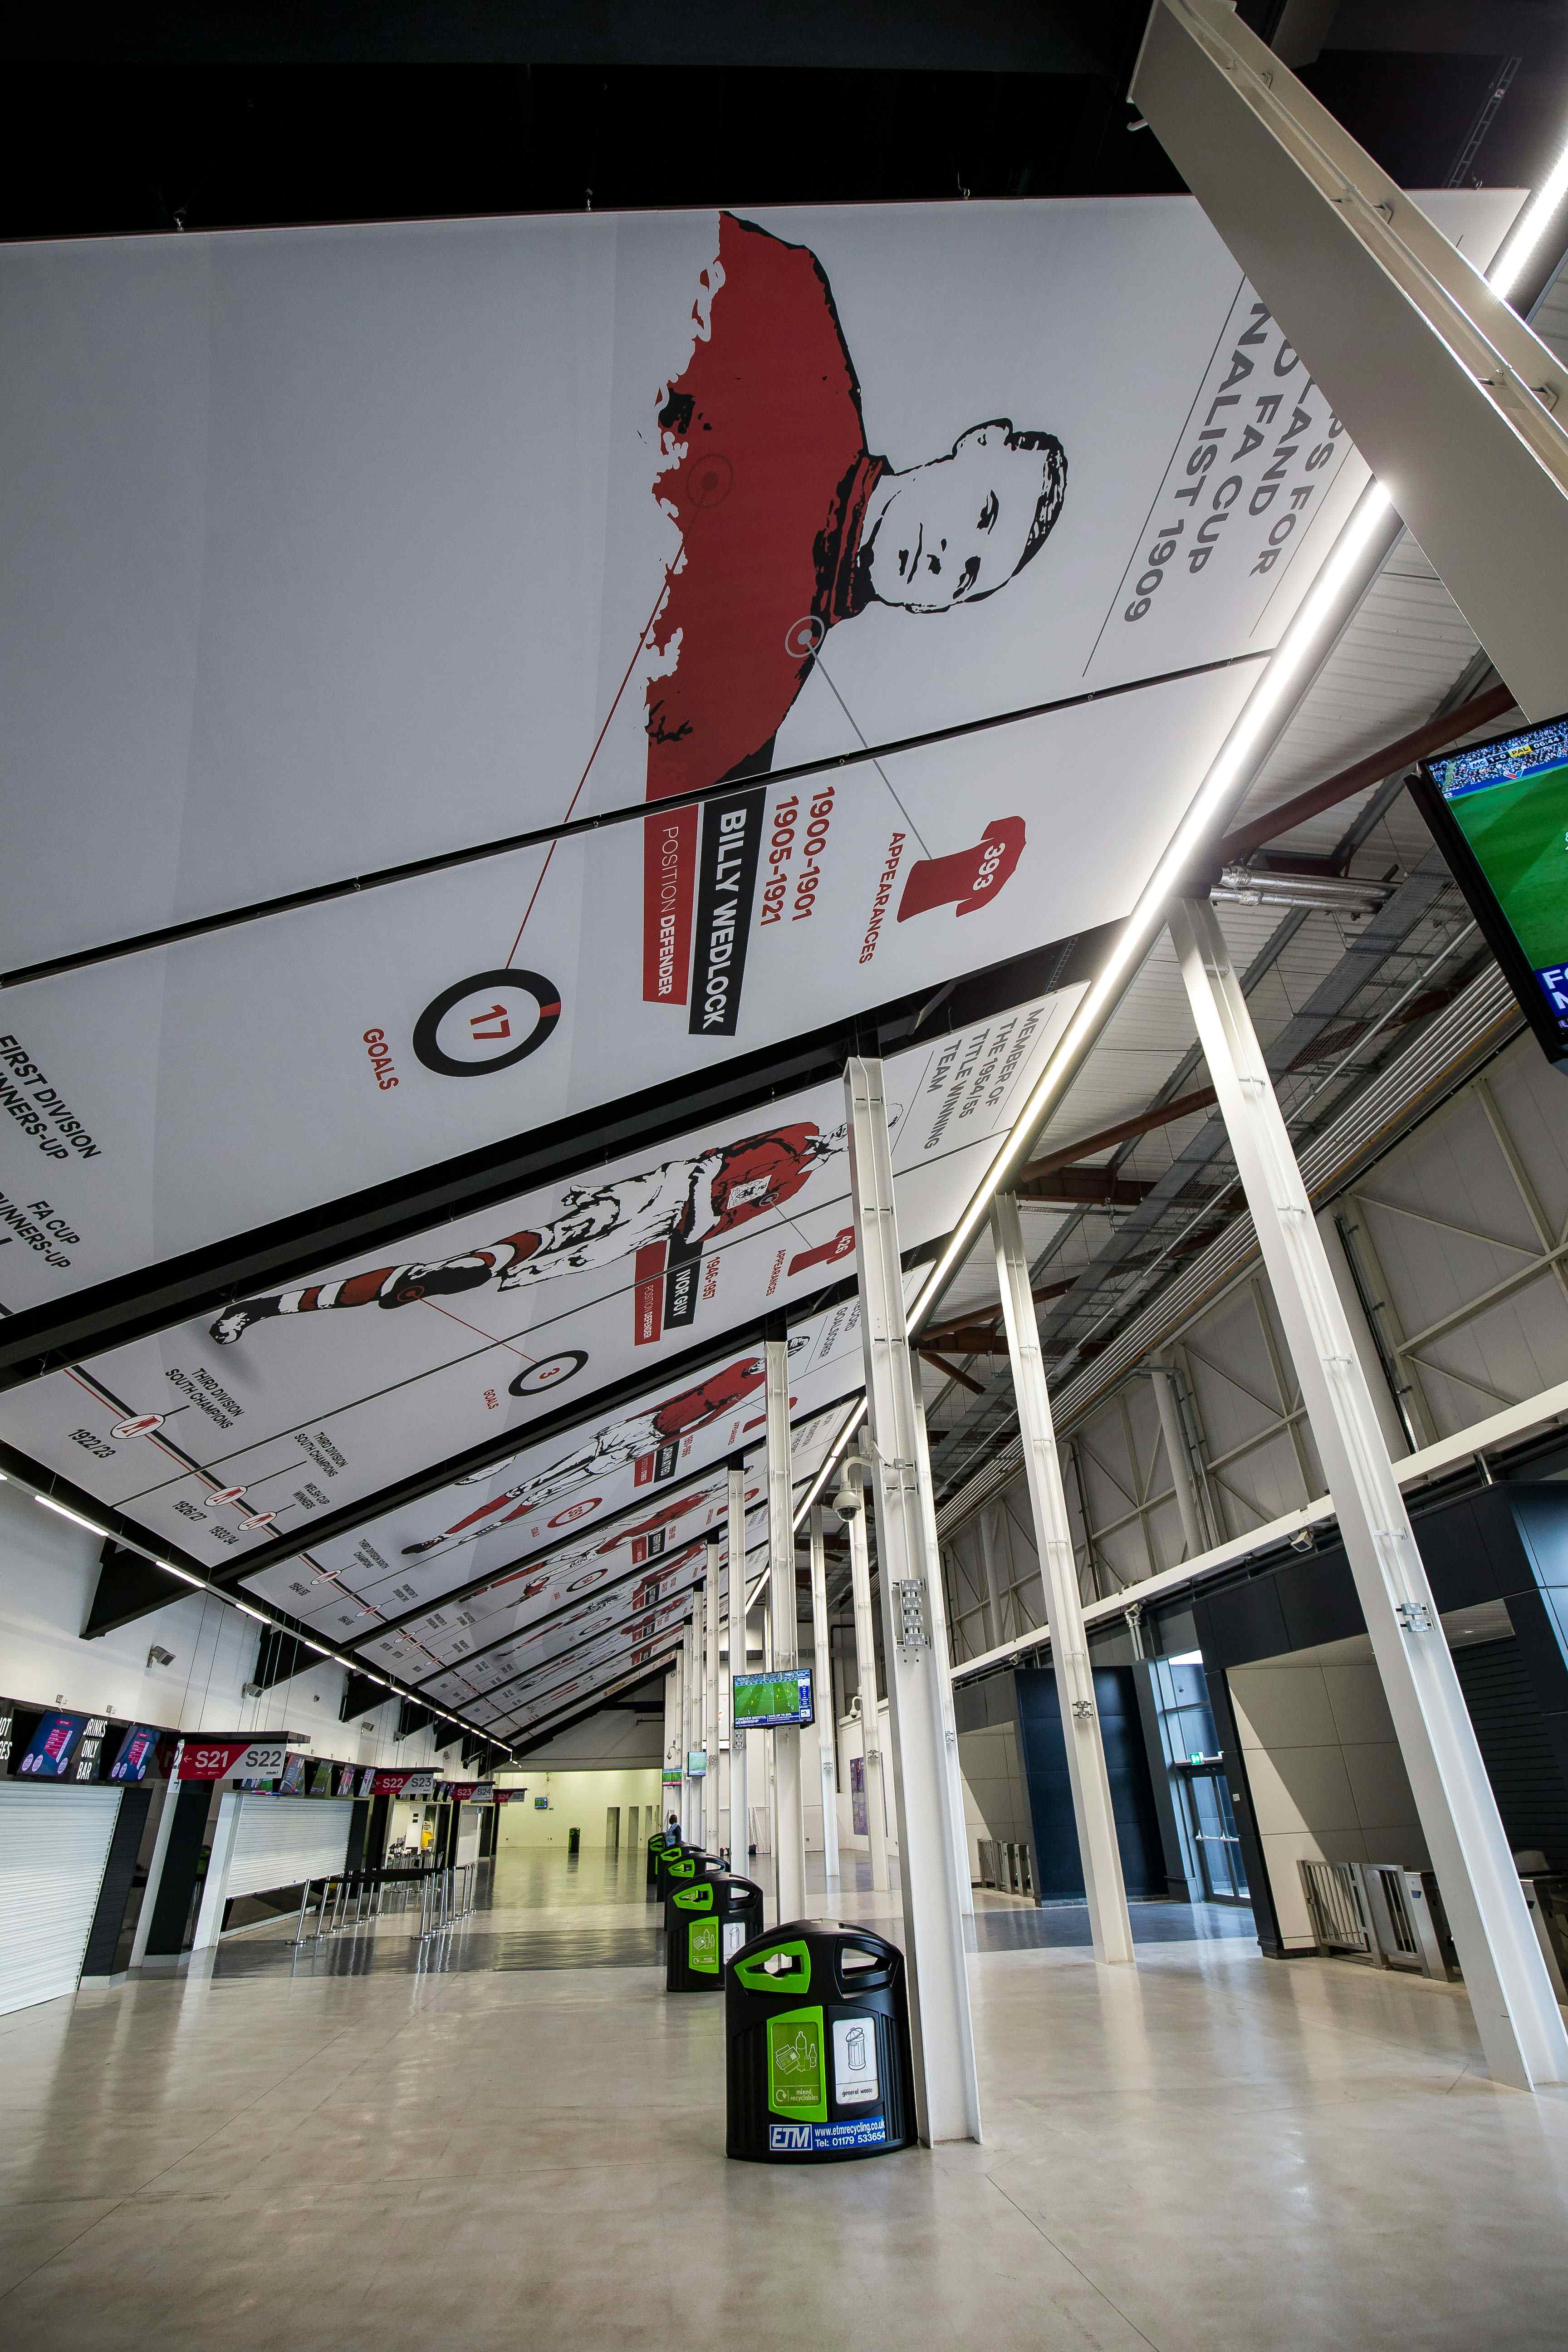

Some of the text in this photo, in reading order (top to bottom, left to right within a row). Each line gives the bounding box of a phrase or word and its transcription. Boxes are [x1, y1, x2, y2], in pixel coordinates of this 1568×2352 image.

[1124, 303, 1272, 622] NALIST 1909
[1187, 394, 1284, 574] FA CUP
[1249, 485, 1314, 577] FOR
[1489, 754, 1506, 762] 1-0
[1511, 747, 1529, 755] PAL
[1534, 737, 1560, 749] 06:44
[760, 794, 799, 926] 1905-1921
[792, 786, 835, 921] 1900-1901
[972, 842, 1006, 892] 393
[658, 826, 679, 997] POSITION DEFENDER
[702, 808, 747, 1030] BILLY WEDLOCK
[858, 831, 906, 965] APPEARANCES
[469, 1004, 511, 1040] 17
[363, 1027, 399, 1091] GOALS
[926, 1039, 962, 1093] TEAM
[958, 1017, 1018, 1119] THE 1954/55
[985, 1008, 1045, 1107] MEMBER OF
[0, 1034, 102, 1160] FIRST DIVISION
[924, 1028, 990, 1150] TITLE WINNING
[26, 1200, 80, 1244] FA CUP
[834, 1235, 853, 1254] 426
[673, 1269, 691, 1317] IVOR GUY
[702, 1256, 720, 1300] 1946-1957
[765, 1249, 786, 1296] APPEARANCES
[643, 1284, 654, 1340] POSITION DEFENDER
[818, 1307, 848, 1360] GOALSCORER
[191, 1367, 245, 1418] THIRD DIVISION
[539, 1367, 561, 1380] 3
[165, 1368, 234, 1430] SOUTH CHAMPIONS
[483, 1389, 500, 1410] GOALS
[68, 1429, 117, 1458] 1922/23
[294, 1433, 339, 1478] SOUTH CHAMPIONS
[313, 1431, 348, 1468] THIRD DIVISION
[172, 1500, 208, 1522] 1926/27
[292, 1490, 316, 1510] WINNERS
[303, 1482, 331, 1507] WELSH CUP
[208, 1525, 240, 1546] 1933/34
[0, 1717, 12, 1737] OT
[81, 1740, 99, 1758] ONLY
[76, 1761, 93, 1780] BAR
[195, 1750, 229, 1768] S21
[245, 1750, 282, 1767] S22
[382, 1778, 403, 1788] S22
[411, 1777, 431, 1788] S23
[842, 2088, 859, 2097] general
[772, 2127, 810, 2148] ETM
[814, 2118, 885, 2136] www.etmrecycling.co.uk
[832, 2136, 854, 2146] 01179
[858, 2131, 886, 2143] 533654
